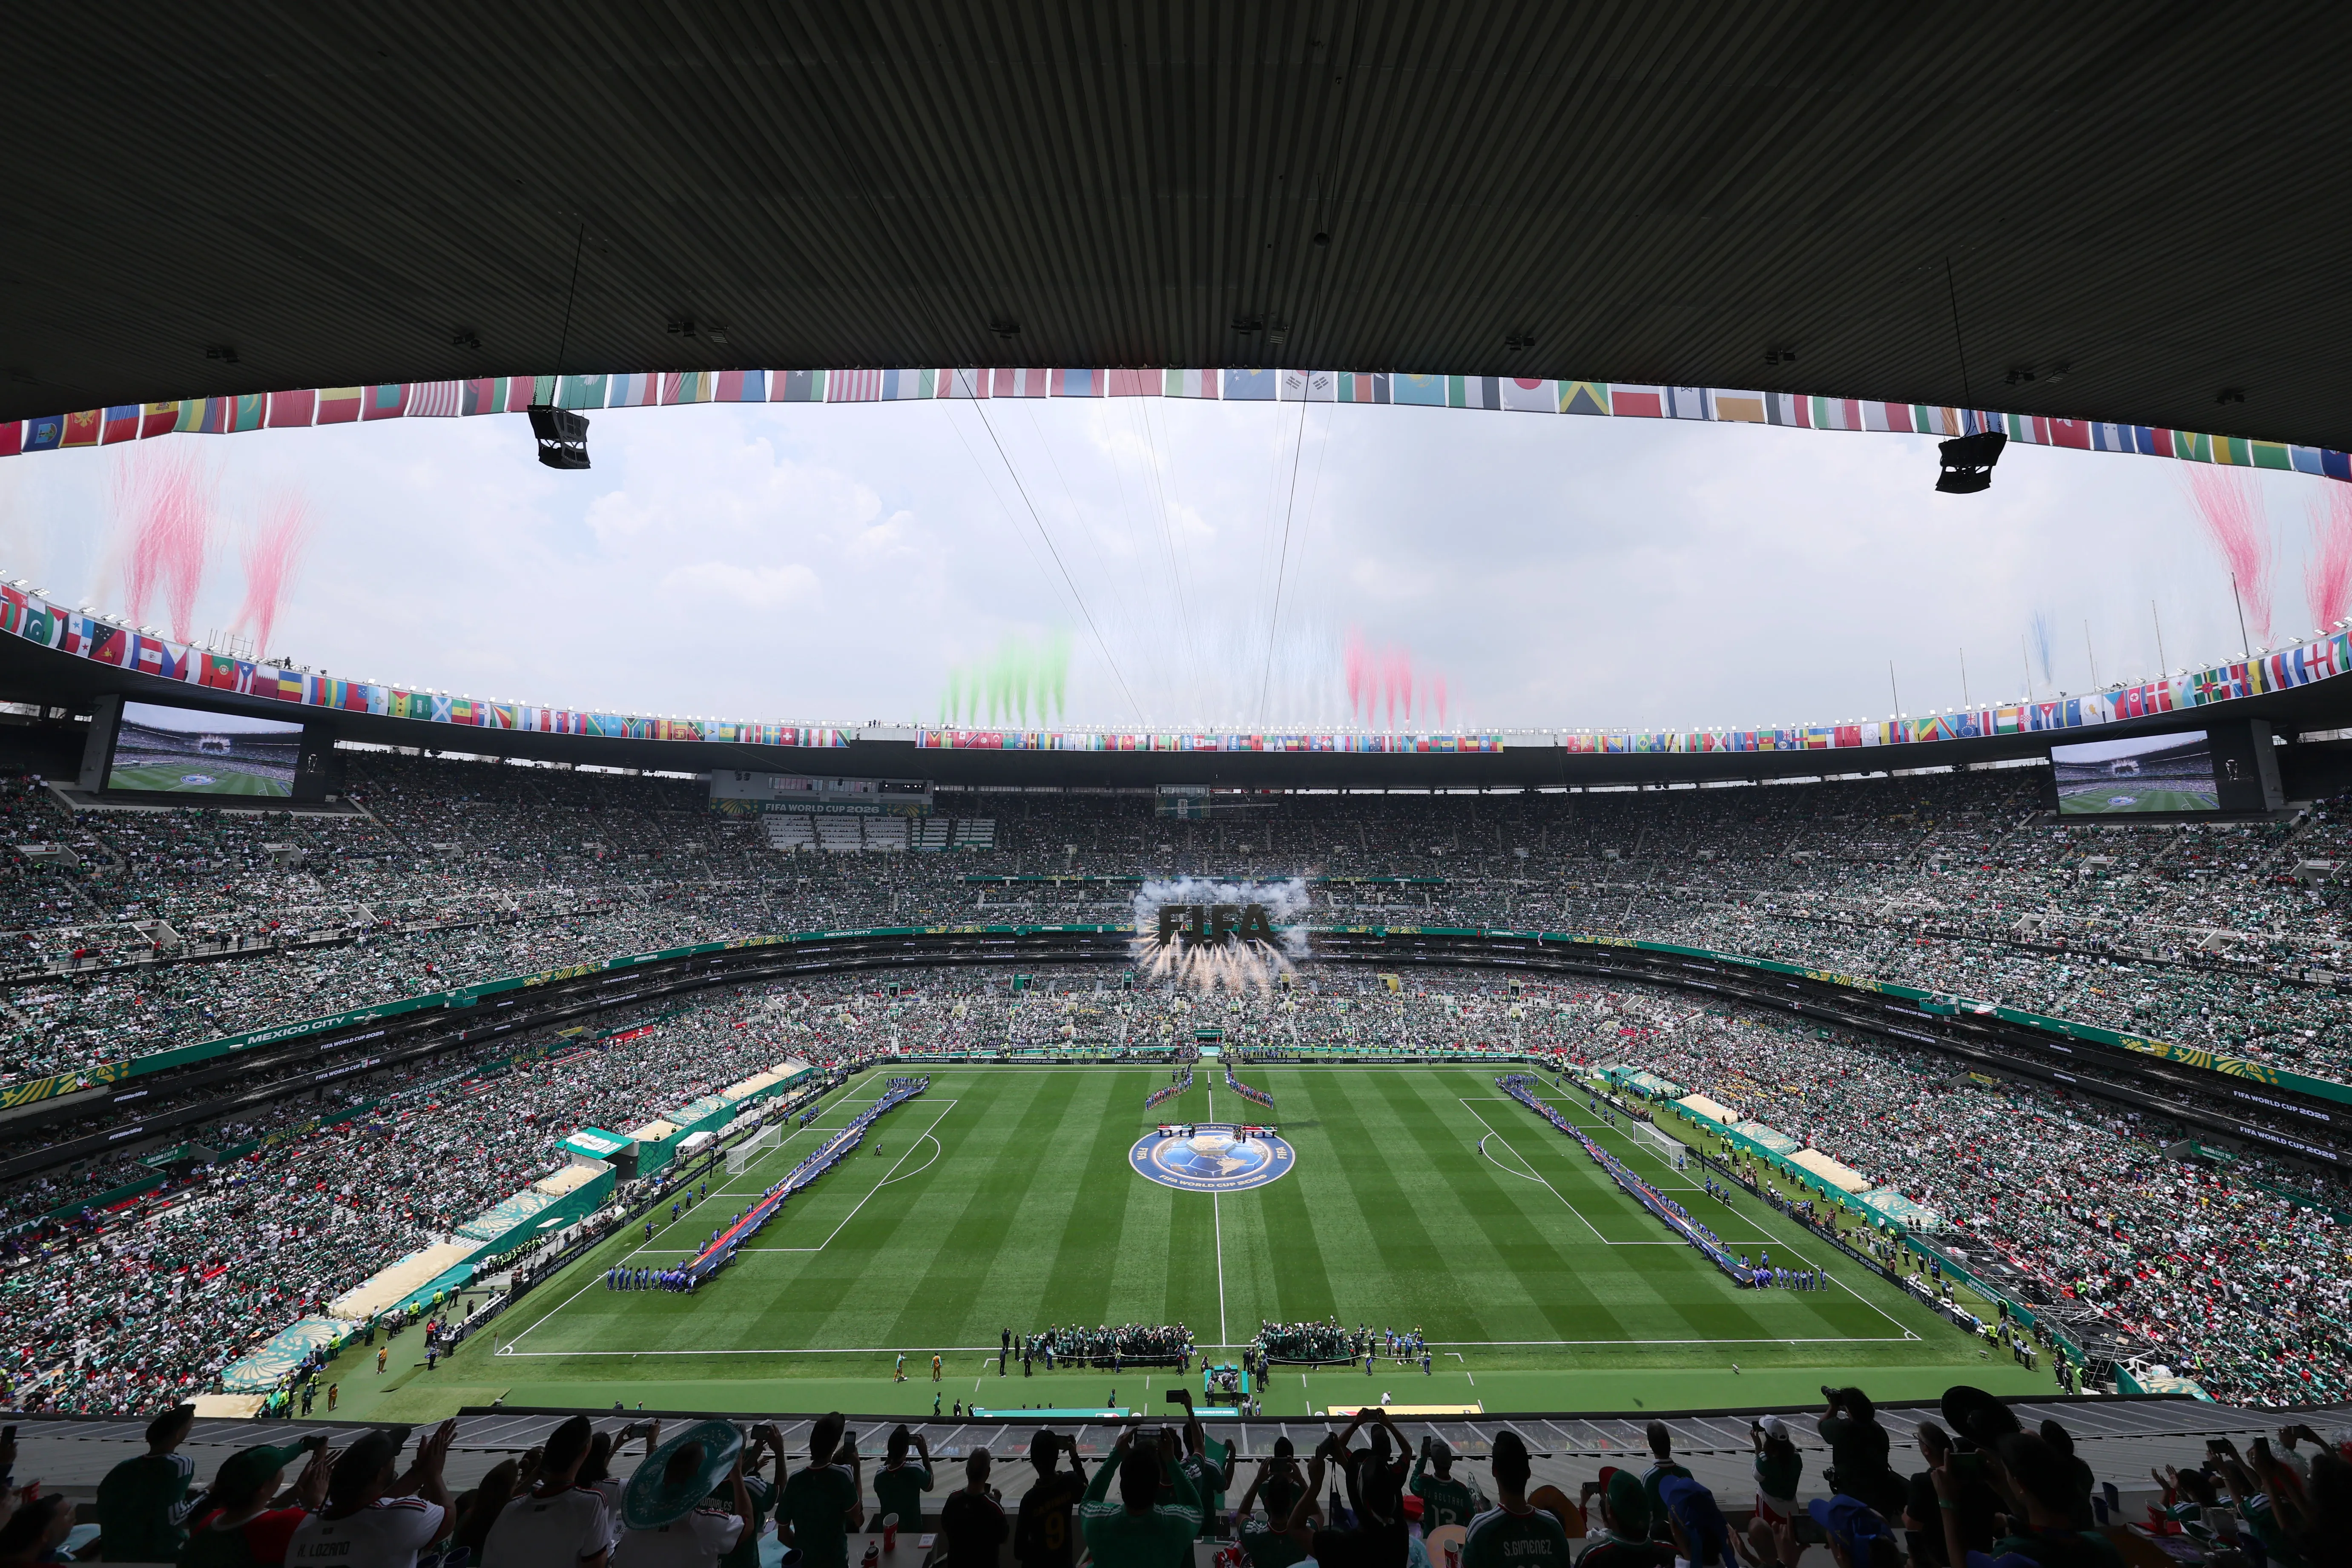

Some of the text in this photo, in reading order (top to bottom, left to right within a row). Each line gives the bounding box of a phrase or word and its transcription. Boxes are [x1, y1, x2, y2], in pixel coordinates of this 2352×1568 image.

[788, 804, 824, 812] WORLD
[1159, 903, 1275, 945] FIFA
[1717, 954, 1744, 963] MEXICO
[247, 1016, 345, 1044] MEXICO CITY
[612, 1017, 660, 1034] MEXICO CITY
[333, 1038, 354, 1047] WORLD
[365, 1030, 385, 1039] 2026
[1921, 1035, 1936, 1043] 2026
[316, 1072, 328, 1081] FIFA
[329, 1067, 350, 1077] WORLD
[425, 1081, 440, 1090] CUP
[440, 1072, 465, 1086] 2026
[113, 1090, 148, 1102] #FIFAWorldCup
[1621, 1109, 1633, 1118] WORLD
[2233, 1091, 2330, 1121] FIFA WORLD CUP 2026
[108, 1127, 143, 1141] #FIFAWorldCup
[2200, 1145, 2215, 1154] SALIDA
[2240, 1126, 2337, 1160] FIFA WORLD CUP 2026
[146, 1154, 164, 1164] SALIDA
[1137, 1147, 1149, 1160] FIFA
[1275, 1147, 1287, 1159] FIFA
[1158, 1175, 1178, 1183] FIFA
[1237, 1173, 1268, 1185] 2026
[1705, 1158, 1719, 1171] WORLD
[1720, 1168, 1728, 1176] CUP
[1729, 1174, 1744, 1187] 2026
[669, 1184, 679, 1194] FIFA
[679, 1173, 695, 1187] WORLD
[695, 1168, 704, 1176] CUP
[1809, 1224, 1883, 1275] FIFA WORLD CUP 2026
[532, 1233, 605, 1287] FIFA WORLD CUP 2026
[1969, 1278, 1982, 1290] COPA
[1973, 1285, 1980, 1293] LA
[1980, 1289, 1990, 1301] FIFA
[1434, 1491, 1464, 1507] BELTRAN
[1431, 1504, 1456, 1528] 13
[1045, 1511, 1065, 1550] 9
[309, 1541, 351, 1557] LOZANO
[1503, 1539, 1553, 1557] S.GIMENEZ
